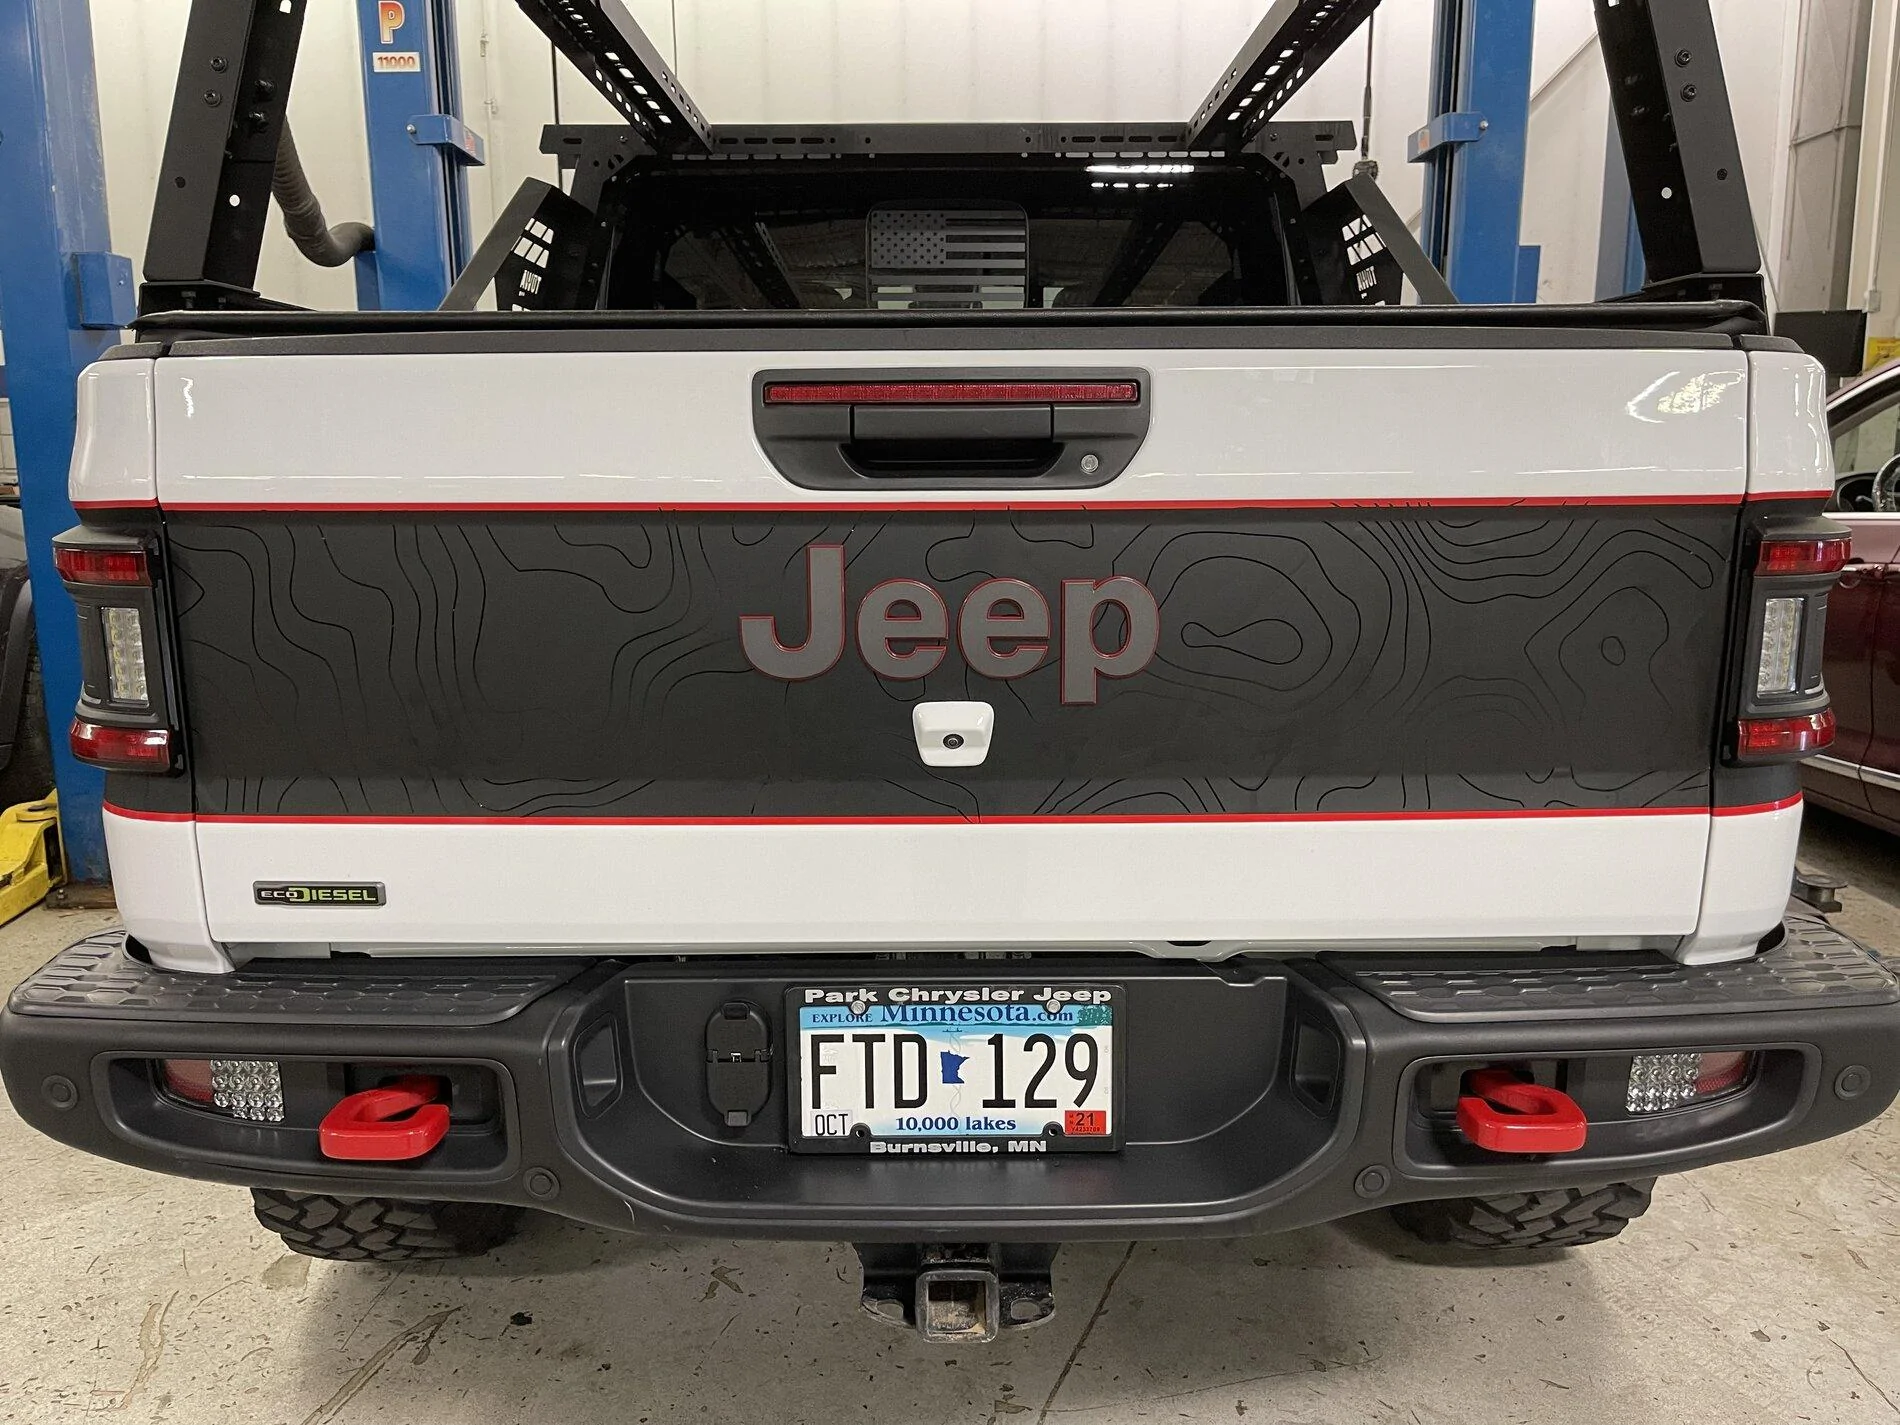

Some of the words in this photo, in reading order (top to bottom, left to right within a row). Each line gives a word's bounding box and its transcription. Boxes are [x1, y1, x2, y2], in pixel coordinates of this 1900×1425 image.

[378, 1, 405, 44] P
[376, 56, 416, 69] 11000
[738, 544, 1160, 705] Jeep
[804, 988, 878, 1004] Park
[888, 987, 1024, 1005] Chrysler
[1033, 987, 1112, 1005] Jeep
[812, 1013, 873, 1023] EXPLORE
[810, 1033, 928, 1109] FTD
[981, 1033, 1099, 1109] 129
[815, 1114, 849, 1136] OCT
[896, 1116, 959, 1132] 10,000
[965, 1116, 1017, 1131] lakes
[1075, 1112, 1094, 1126] 21
[869, 1140, 999, 1154] Burnsville,
[1007, 1140, 1047, 1153] MN
